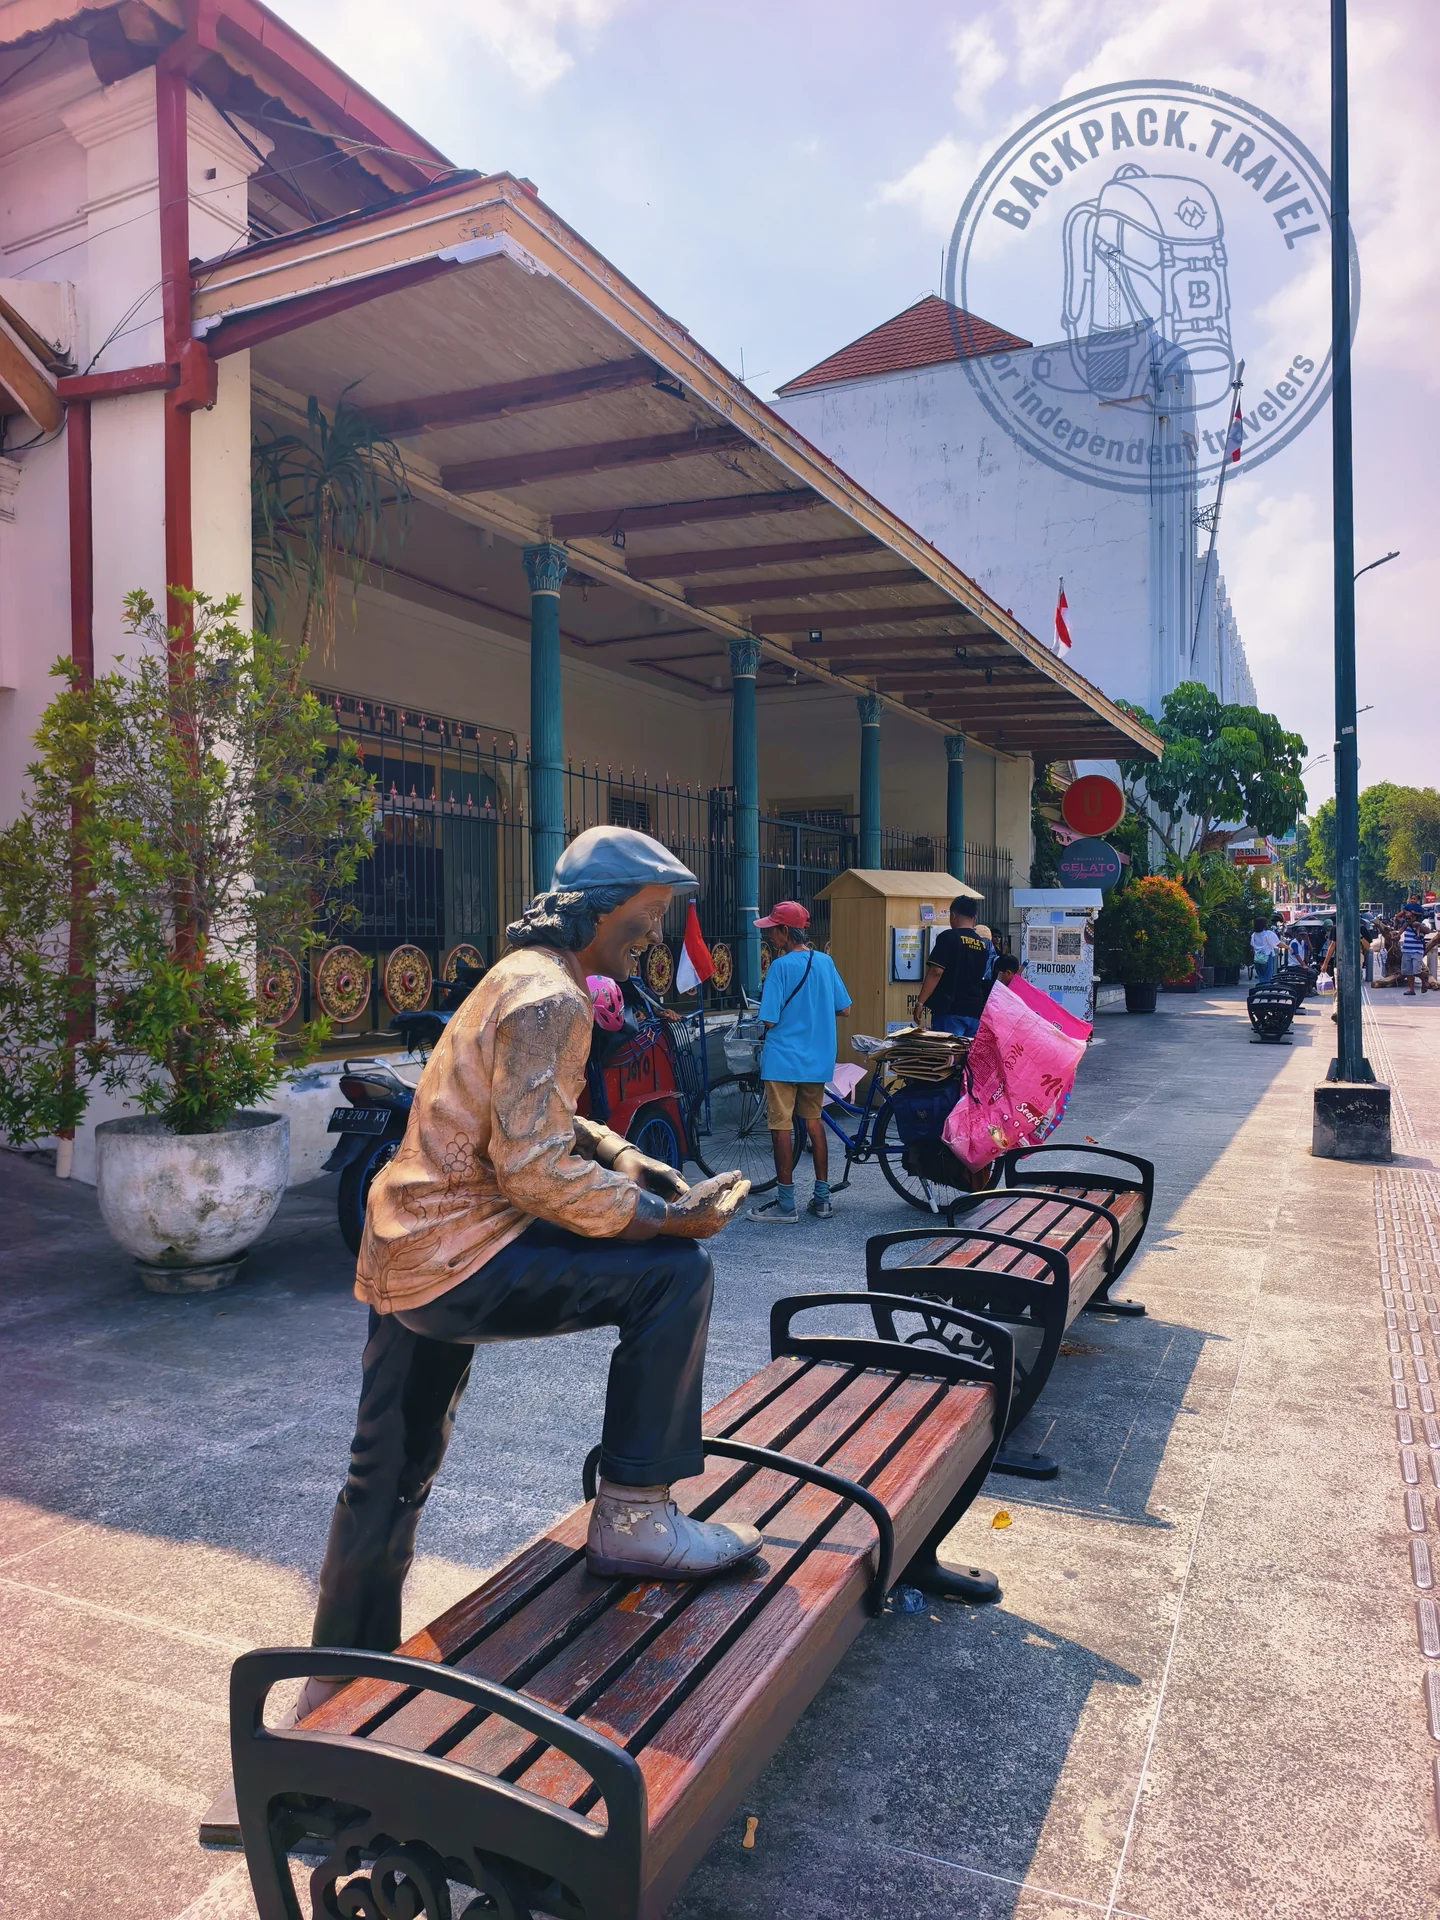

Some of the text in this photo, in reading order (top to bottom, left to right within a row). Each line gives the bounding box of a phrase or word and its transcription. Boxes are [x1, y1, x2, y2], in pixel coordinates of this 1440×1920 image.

[1245, 848, 1261, 856] BNI
[1061, 863, 1116, 873] GELATO
[1037, 963, 1076, 974] PHOTOBOX
[333, 1109, 388, 1122] AB 2701 XX
